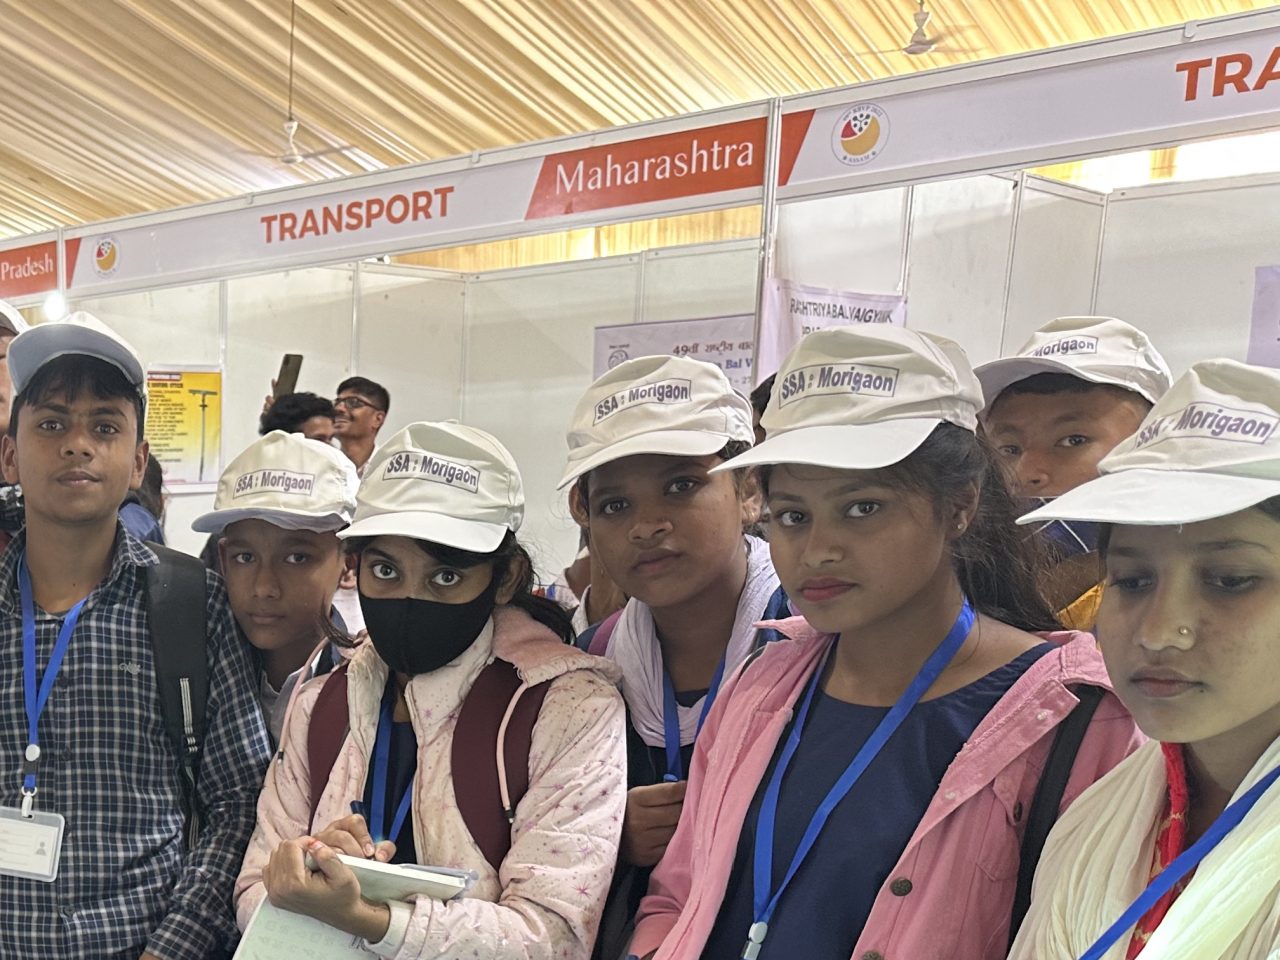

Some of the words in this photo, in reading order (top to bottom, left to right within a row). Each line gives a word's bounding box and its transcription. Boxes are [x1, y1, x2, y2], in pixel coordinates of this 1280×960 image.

[1176, 46, 1280, 101] TRA
[556, 139, 754, 195] Maharashtra
[260, 186, 455, 244] TRANSPORT
[1, 252, 54, 280] Pradesh
[725, 358, 742, 369] Bal
[782, 371, 805, 400] SSA
[817, 366, 893, 393] Morigaon
[597, 395, 619, 420] SSA
[628, 384, 688, 403] Morigaon
[1172, 405, 1272, 437] Morigaon
[236, 474, 253, 493] SSA
[261, 471, 312, 492] Morigaon
[386, 454, 410, 473] SSA
[420, 455, 477, 487] Morigaon
